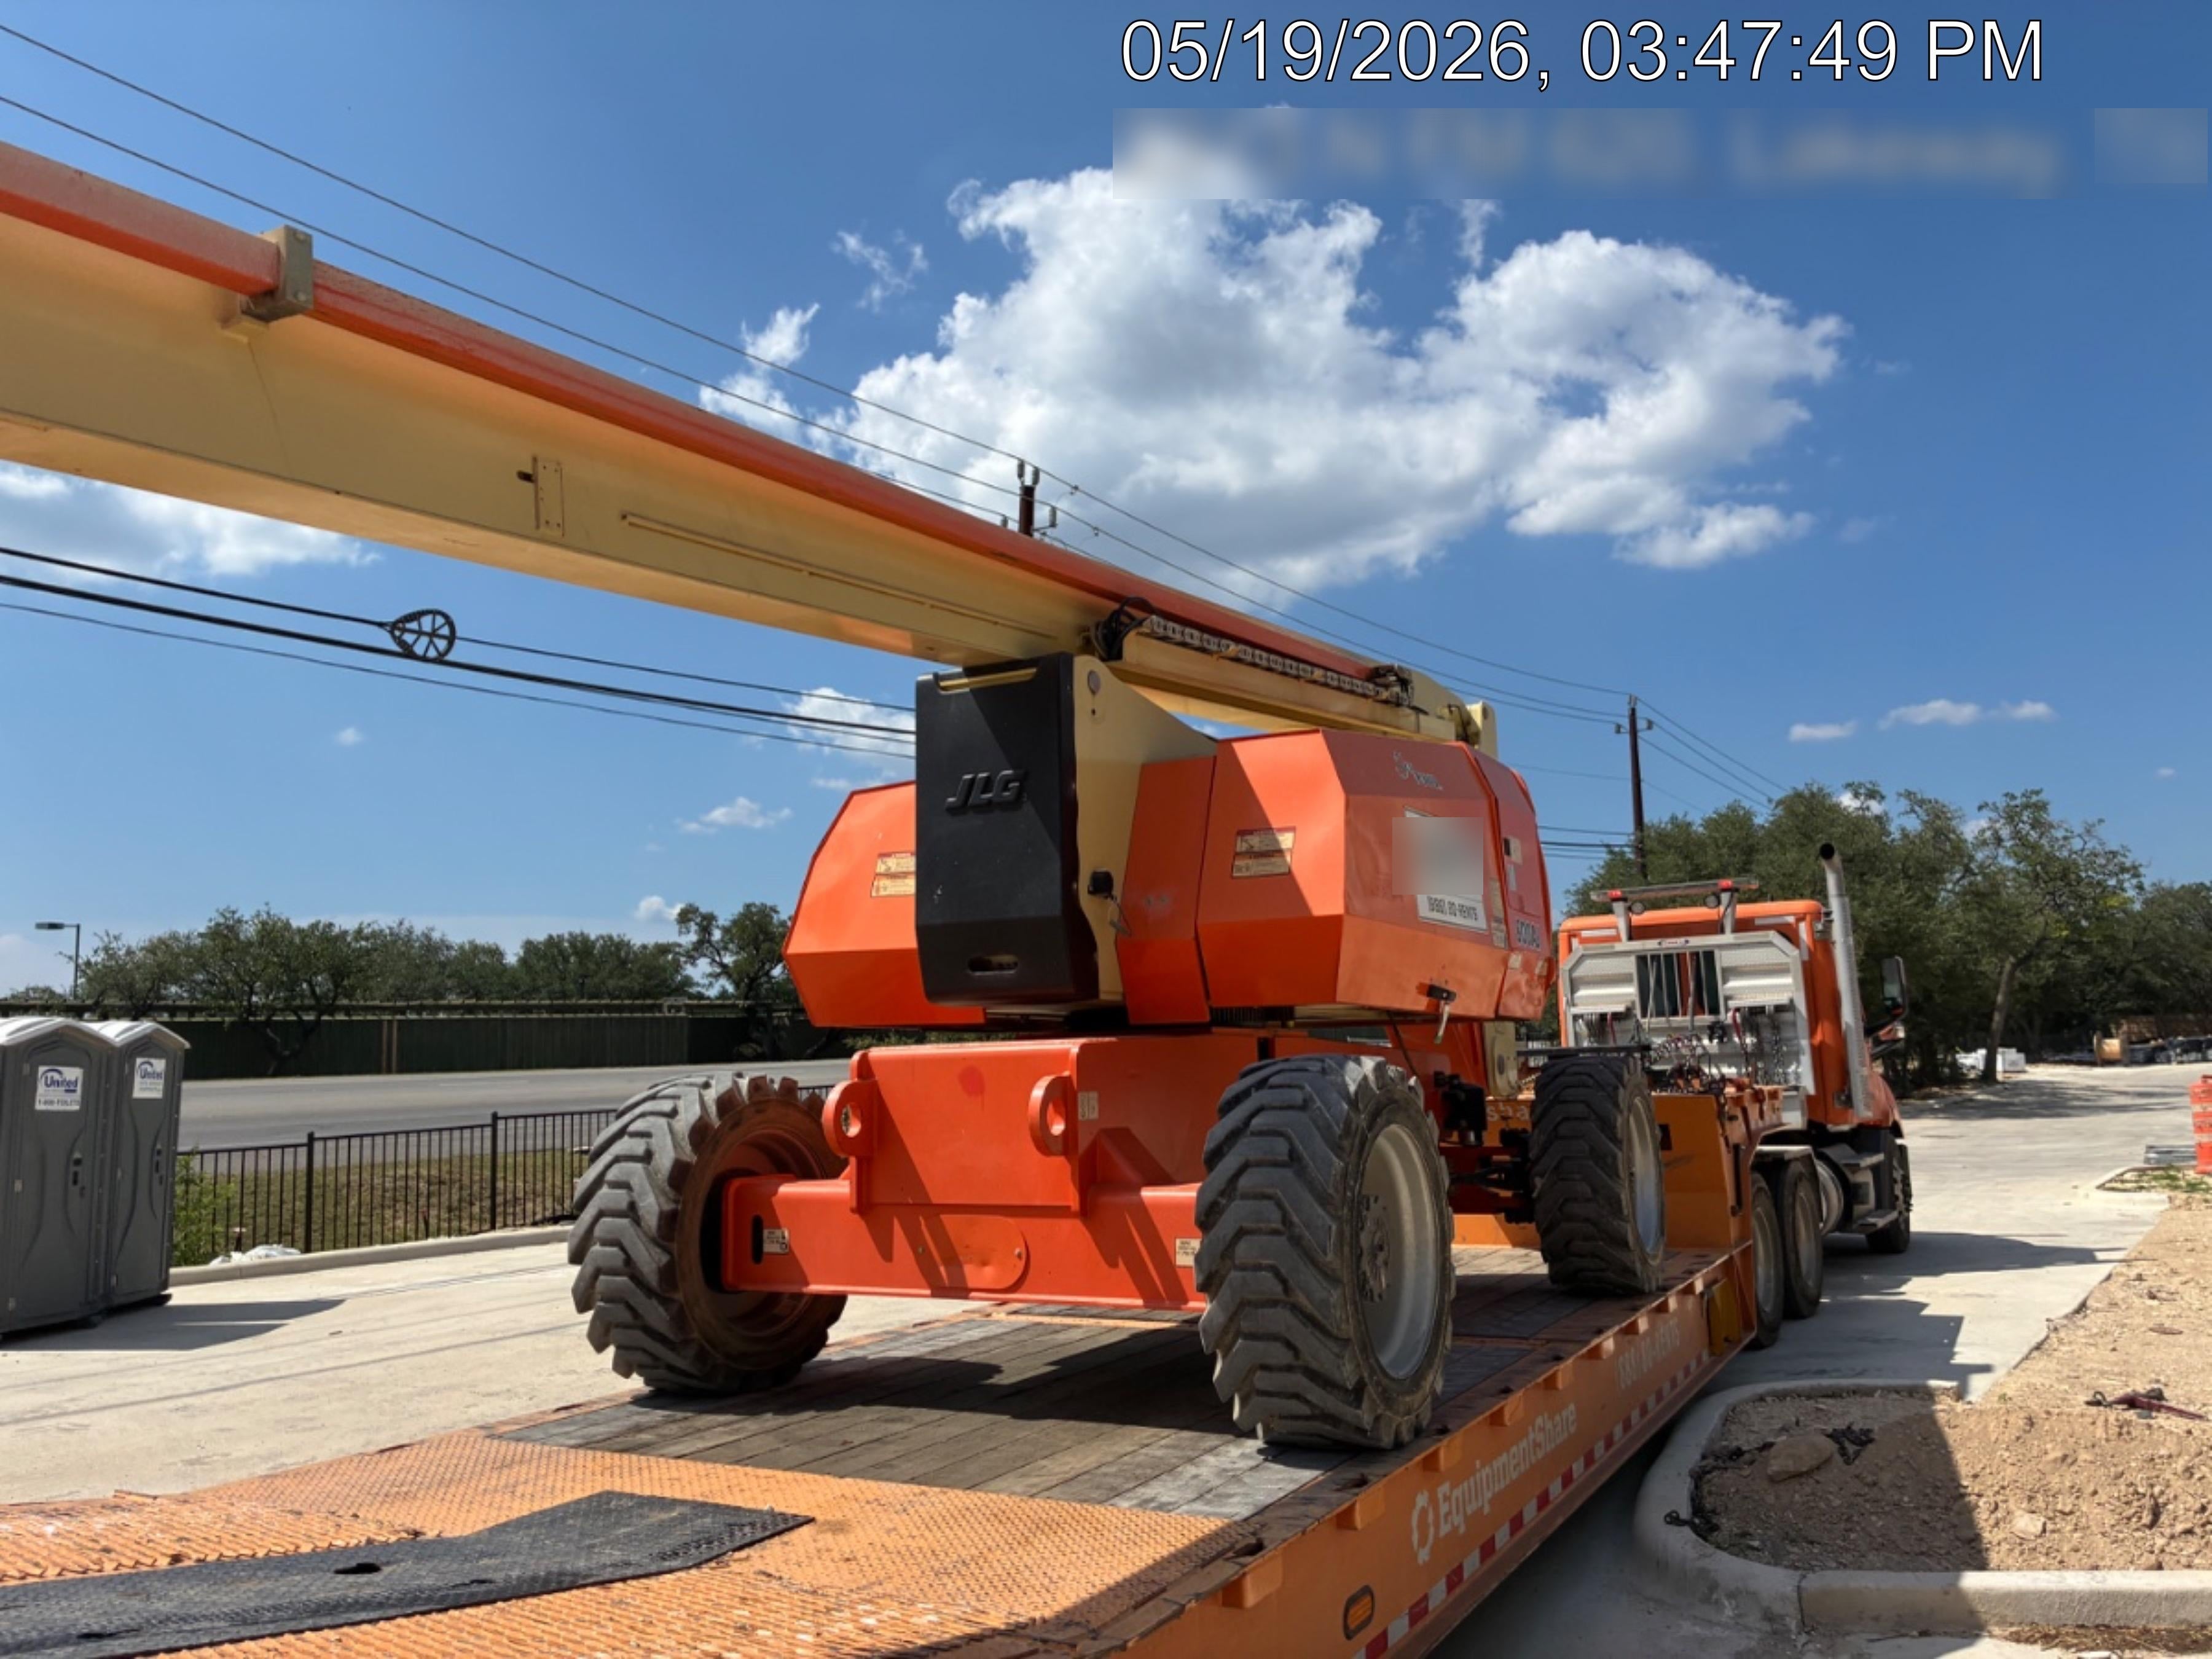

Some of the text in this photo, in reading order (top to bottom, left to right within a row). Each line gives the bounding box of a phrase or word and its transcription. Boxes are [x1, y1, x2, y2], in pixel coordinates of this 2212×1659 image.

[945, 770, 1025, 810] JLG
[44, 1075, 78, 1088] United
[1437, 1402, 1578, 1538] EquipmentShare
